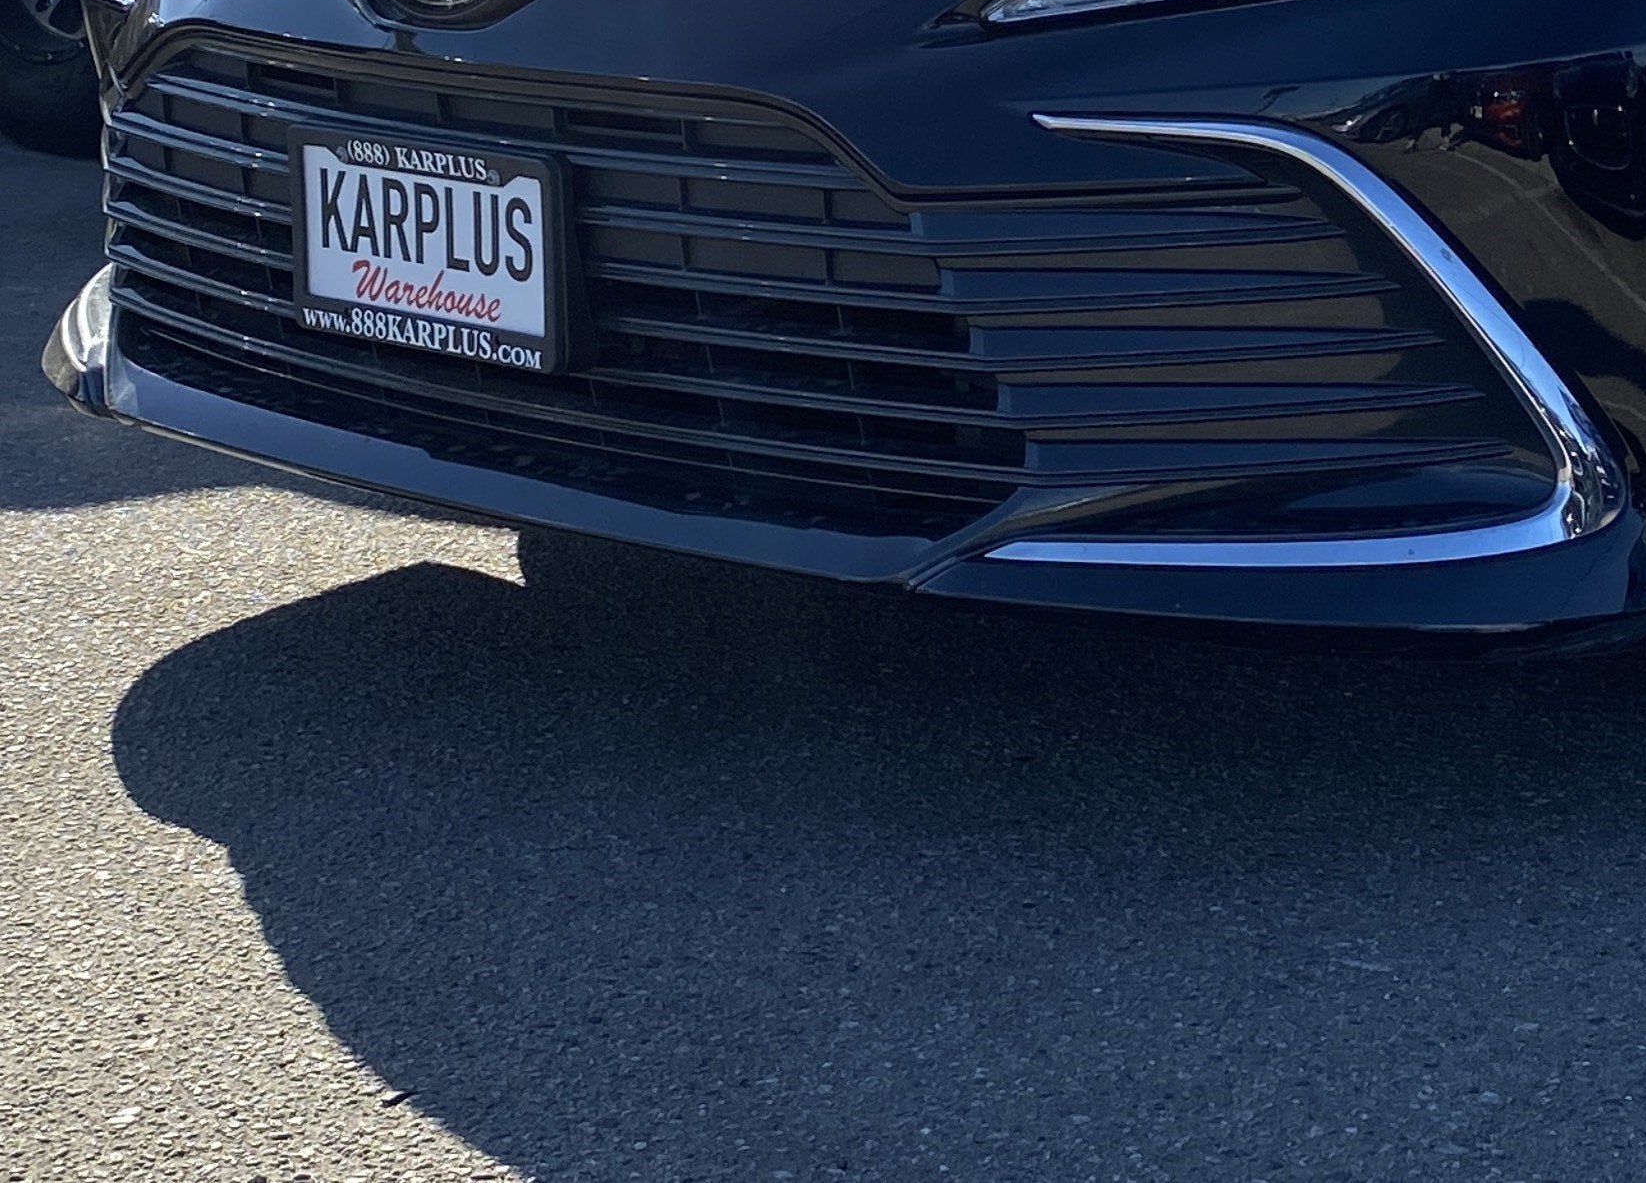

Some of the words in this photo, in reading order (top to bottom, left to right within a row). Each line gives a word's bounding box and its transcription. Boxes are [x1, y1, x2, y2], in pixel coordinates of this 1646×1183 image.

[346, 139, 391, 165] (888)
[395, 146, 488, 181] KARPLUS
[319, 167, 534, 282] KARPLUS
[351, 259, 502, 323] Warehouse
